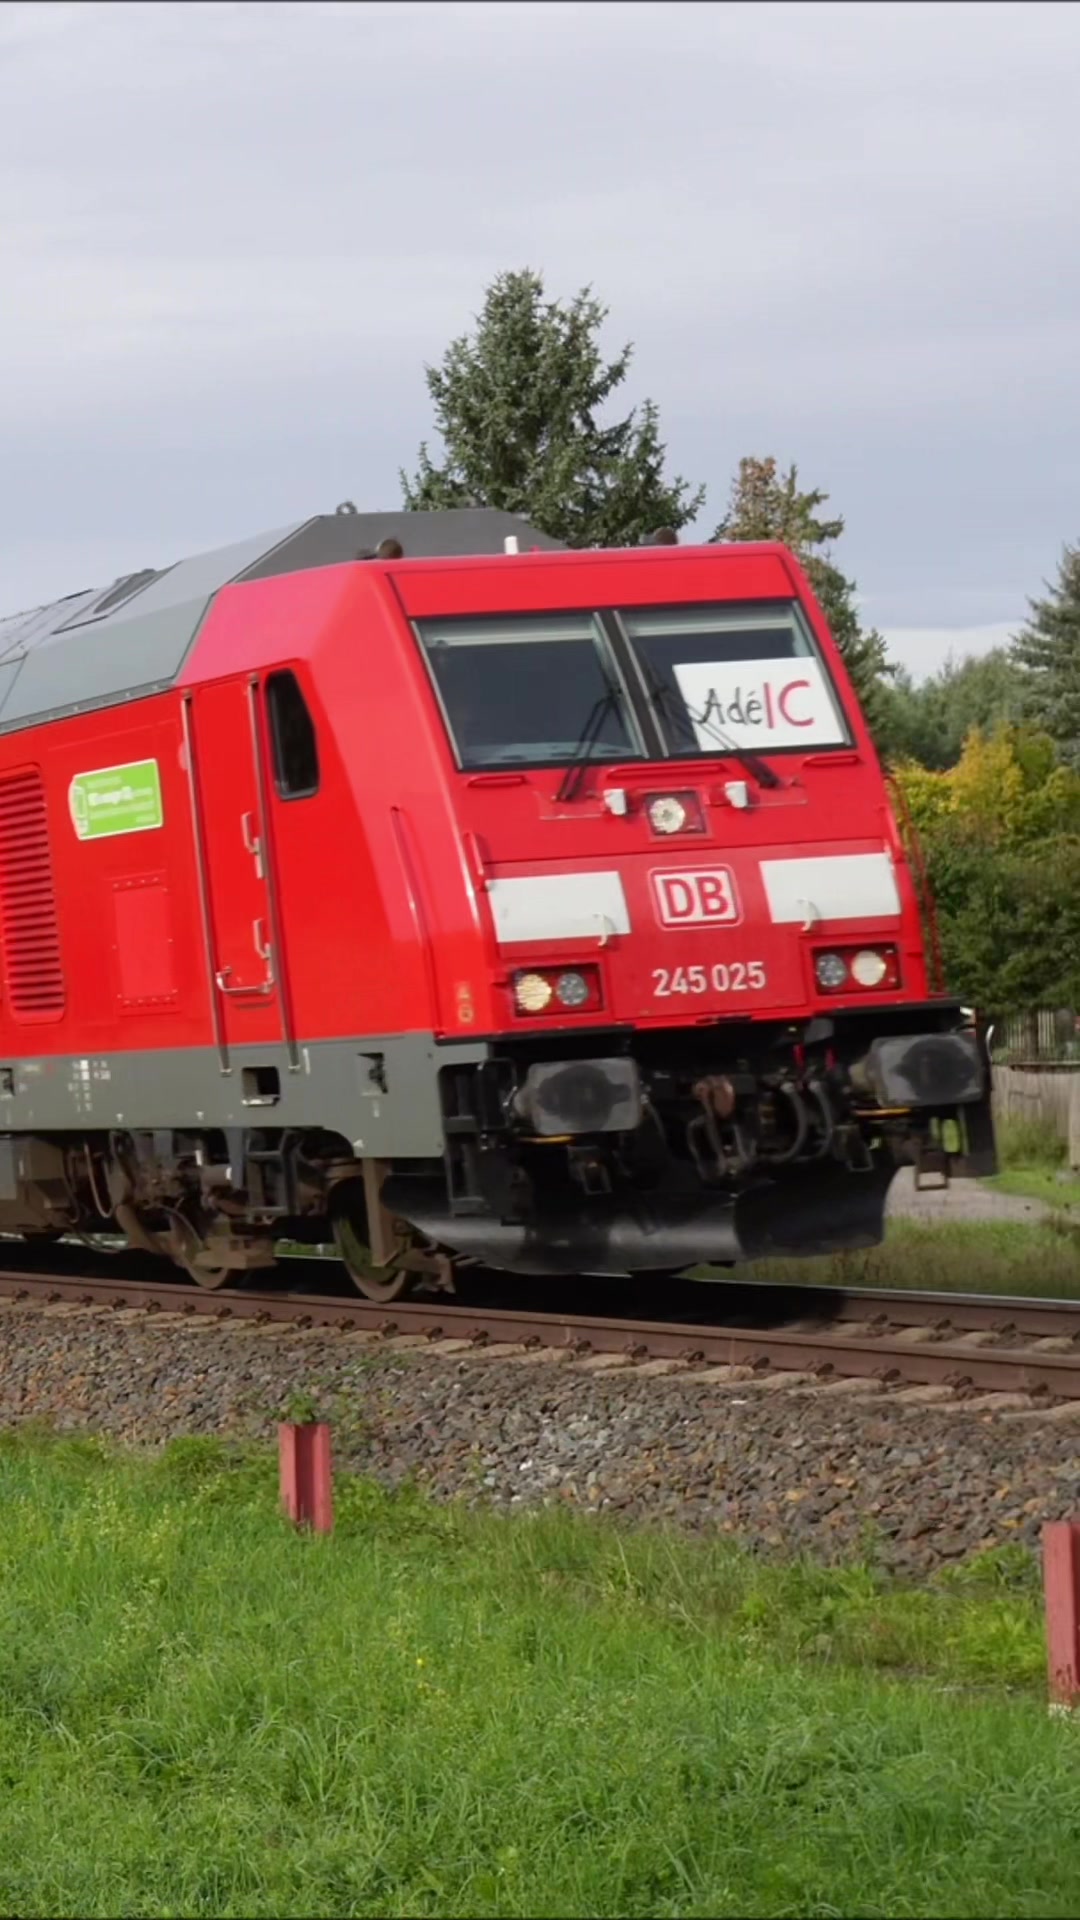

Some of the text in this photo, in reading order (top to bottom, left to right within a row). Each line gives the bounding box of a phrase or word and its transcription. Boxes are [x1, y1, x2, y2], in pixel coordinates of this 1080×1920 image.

[662, 876, 728, 918] DB
[652, 961, 766, 996] 245 025
